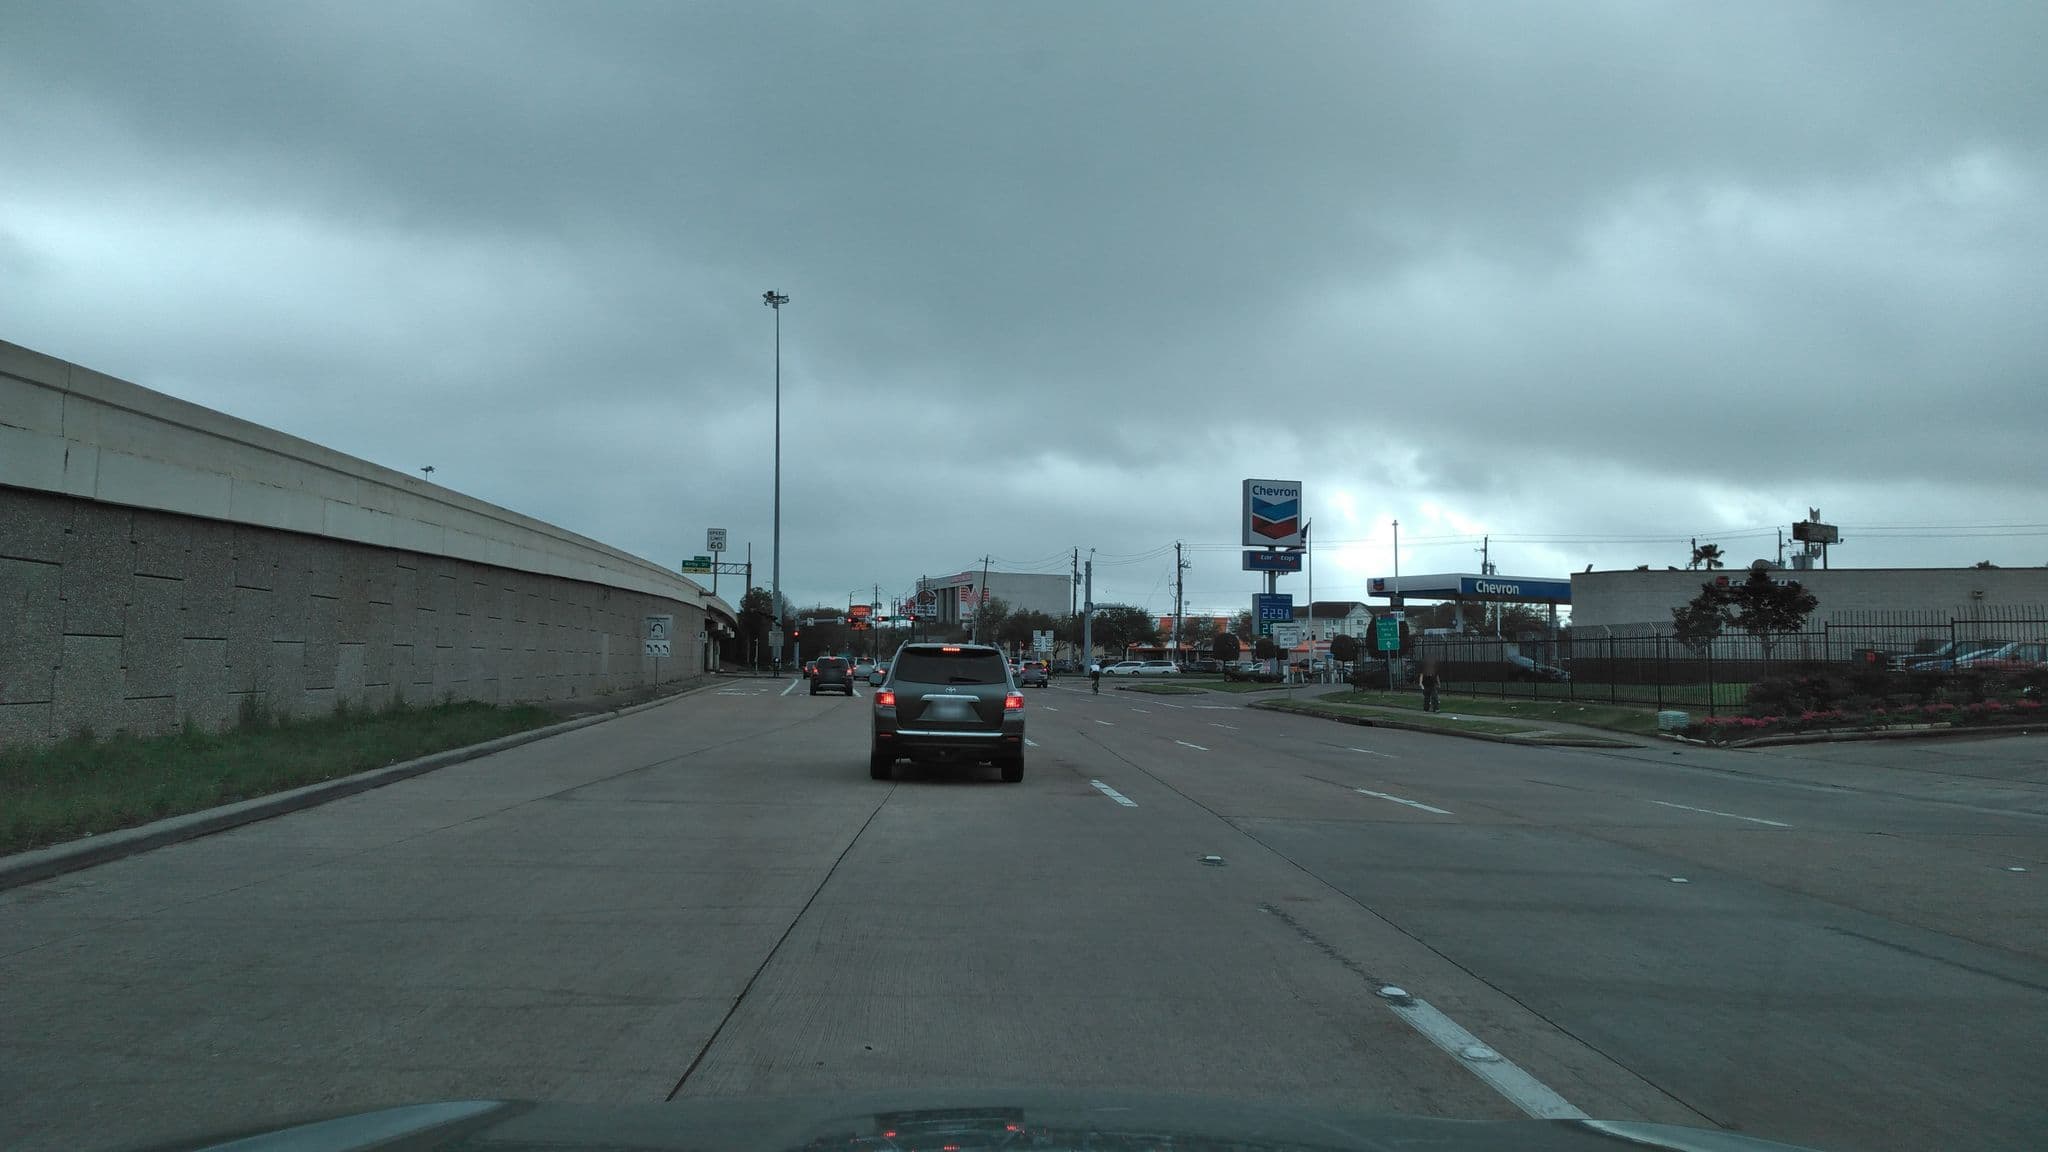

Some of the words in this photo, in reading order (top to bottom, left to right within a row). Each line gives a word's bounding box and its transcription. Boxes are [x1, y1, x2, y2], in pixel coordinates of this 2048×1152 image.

[1252, 485, 1298, 497] Chevron
[710, 542, 723, 550] 60
[1475, 580, 1520, 595] Chevron
